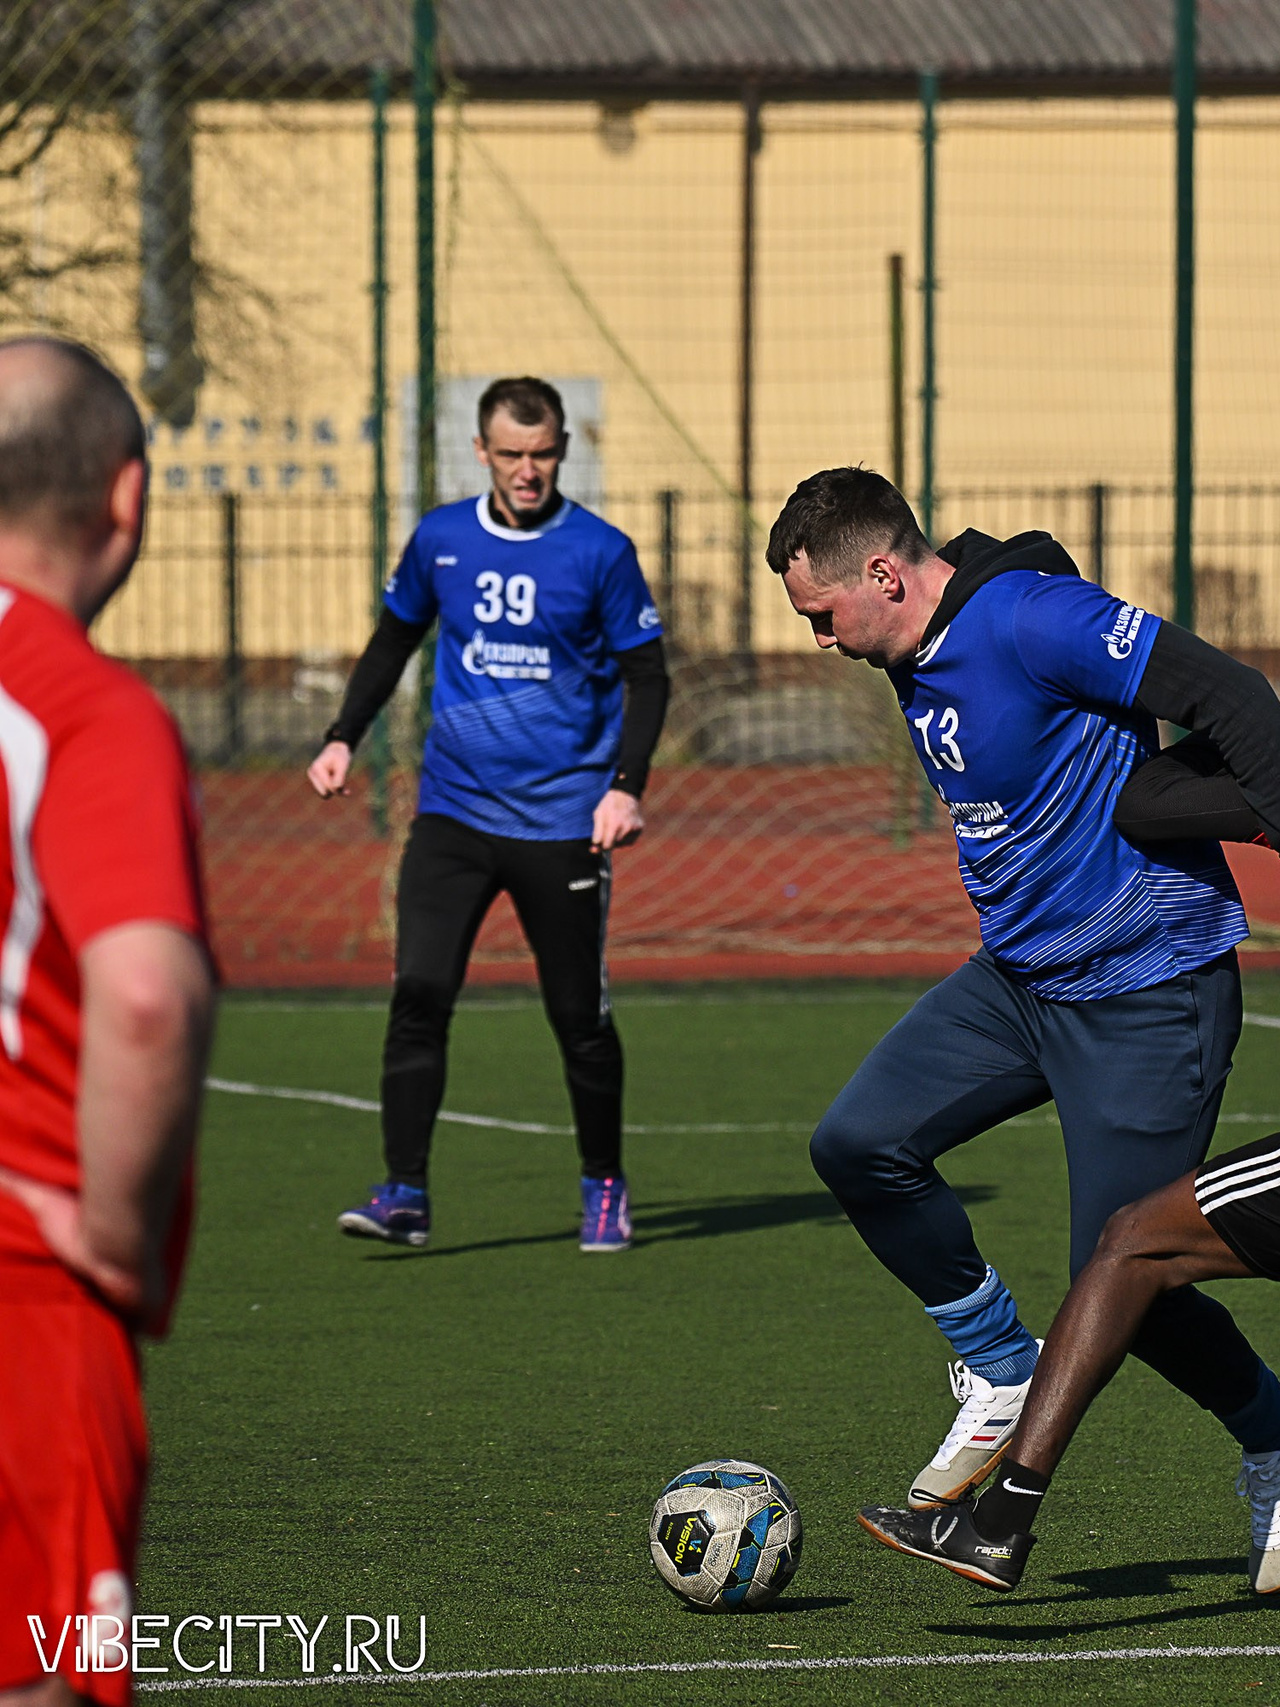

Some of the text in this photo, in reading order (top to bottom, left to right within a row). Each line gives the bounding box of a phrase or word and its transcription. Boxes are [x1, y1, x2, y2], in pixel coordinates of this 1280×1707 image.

[473, 570, 537, 626] 39
[914, 707, 965, 773] 13
[674, 1517, 697, 1564] VISION
